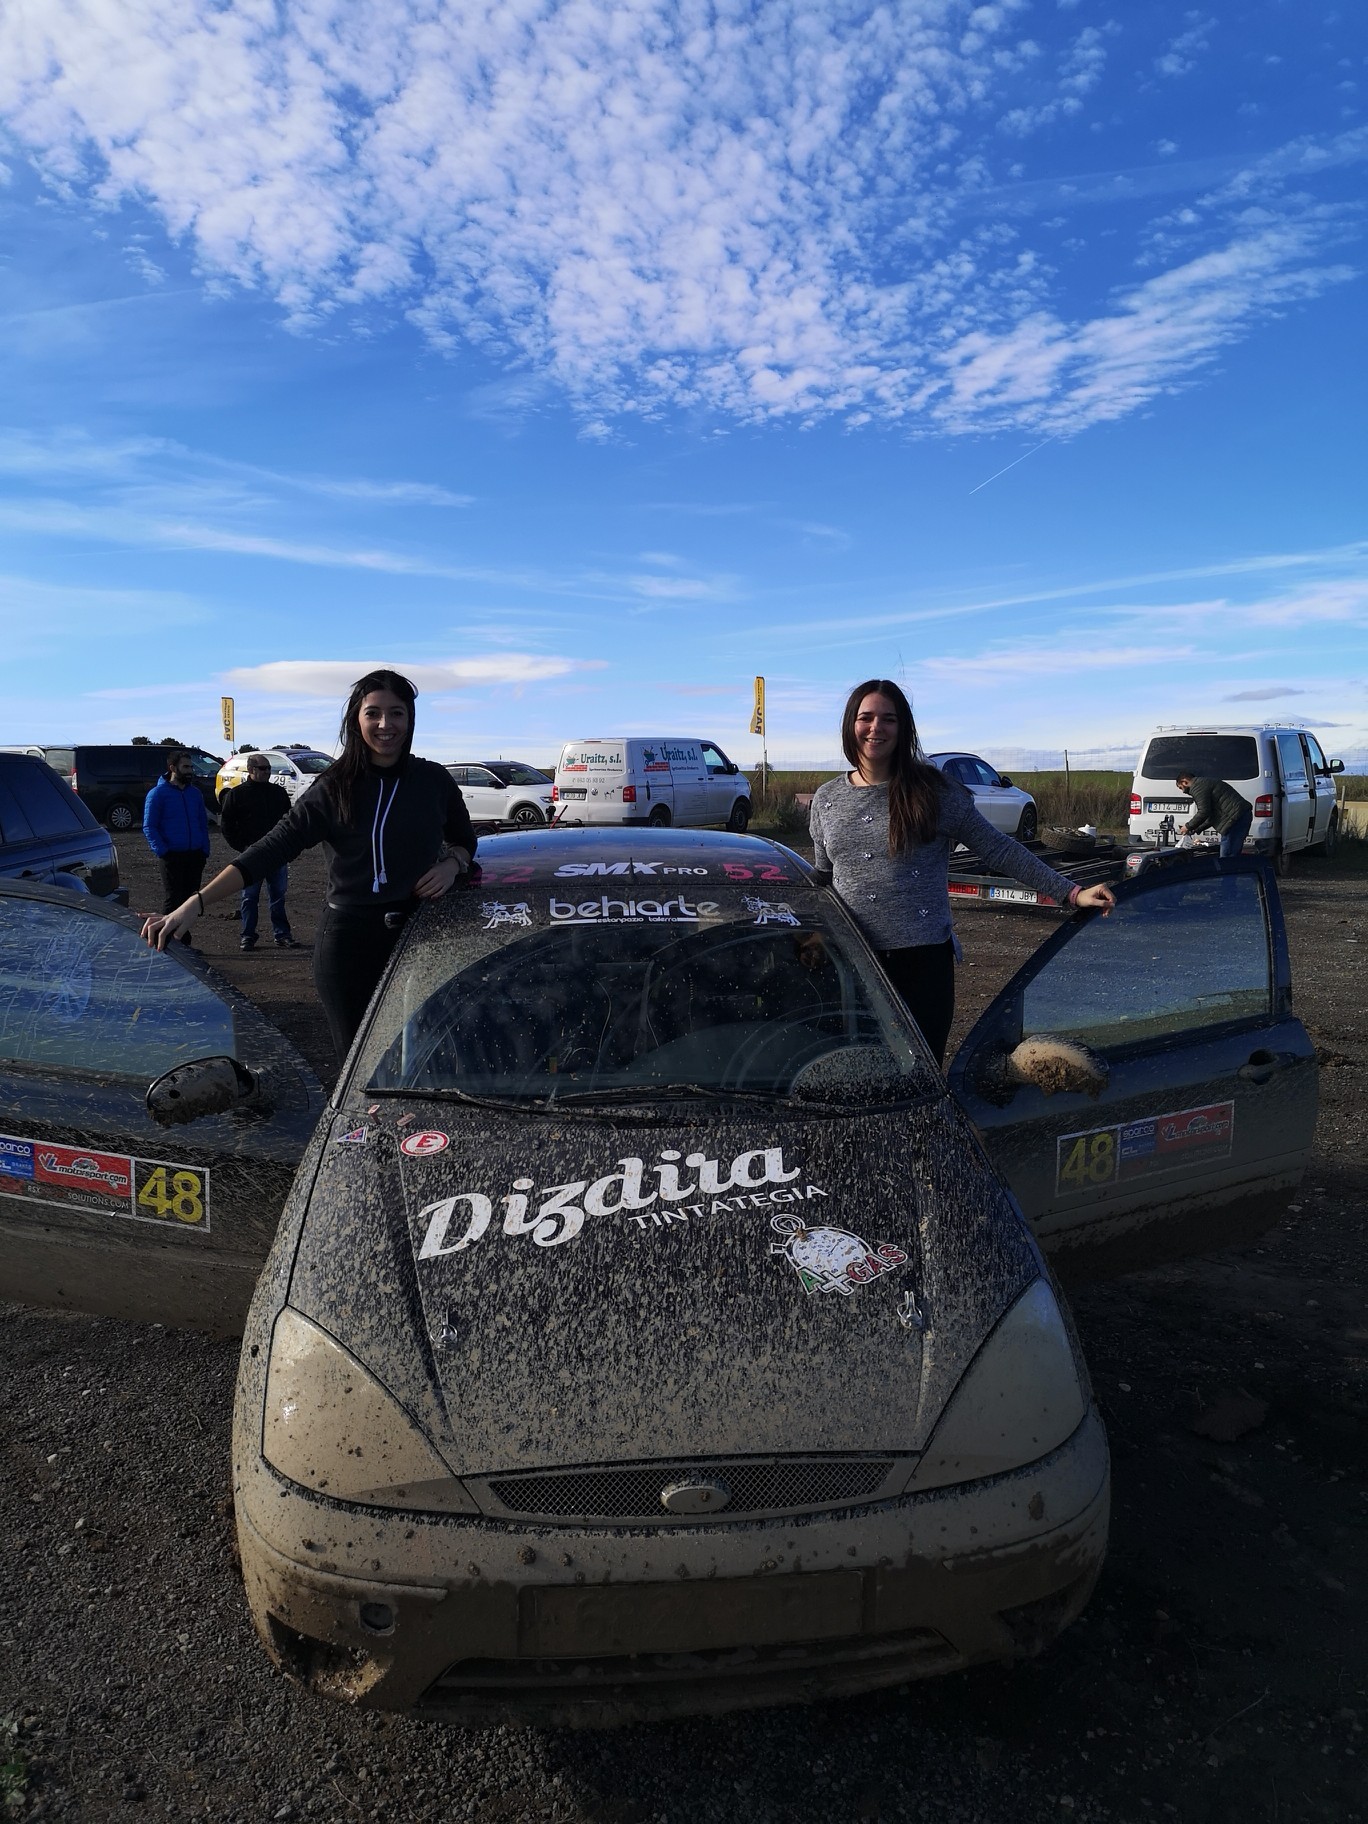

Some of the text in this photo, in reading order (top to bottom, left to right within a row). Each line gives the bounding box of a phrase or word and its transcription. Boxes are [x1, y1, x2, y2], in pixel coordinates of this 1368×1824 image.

[580, 753, 622, 765] Uraitz, s.l.
[1153, 803, 1188, 811] 3114 JBY
[553, 862, 708, 878] SMX PRO
[722, 863, 790, 881] 52
[996, 891, 1035, 902] 3114 JBY
[549, 895, 721, 919] behiarte
[415, 1134, 438, 1149] E
[1060, 1133, 1114, 1185] 48
[58, 1165, 127, 1184] motorsport.com
[138, 1166, 205, 1225] 48
[418, 1147, 801, 1260] Dizdira
[628, 1184, 829, 1230] TINTATEGIA
